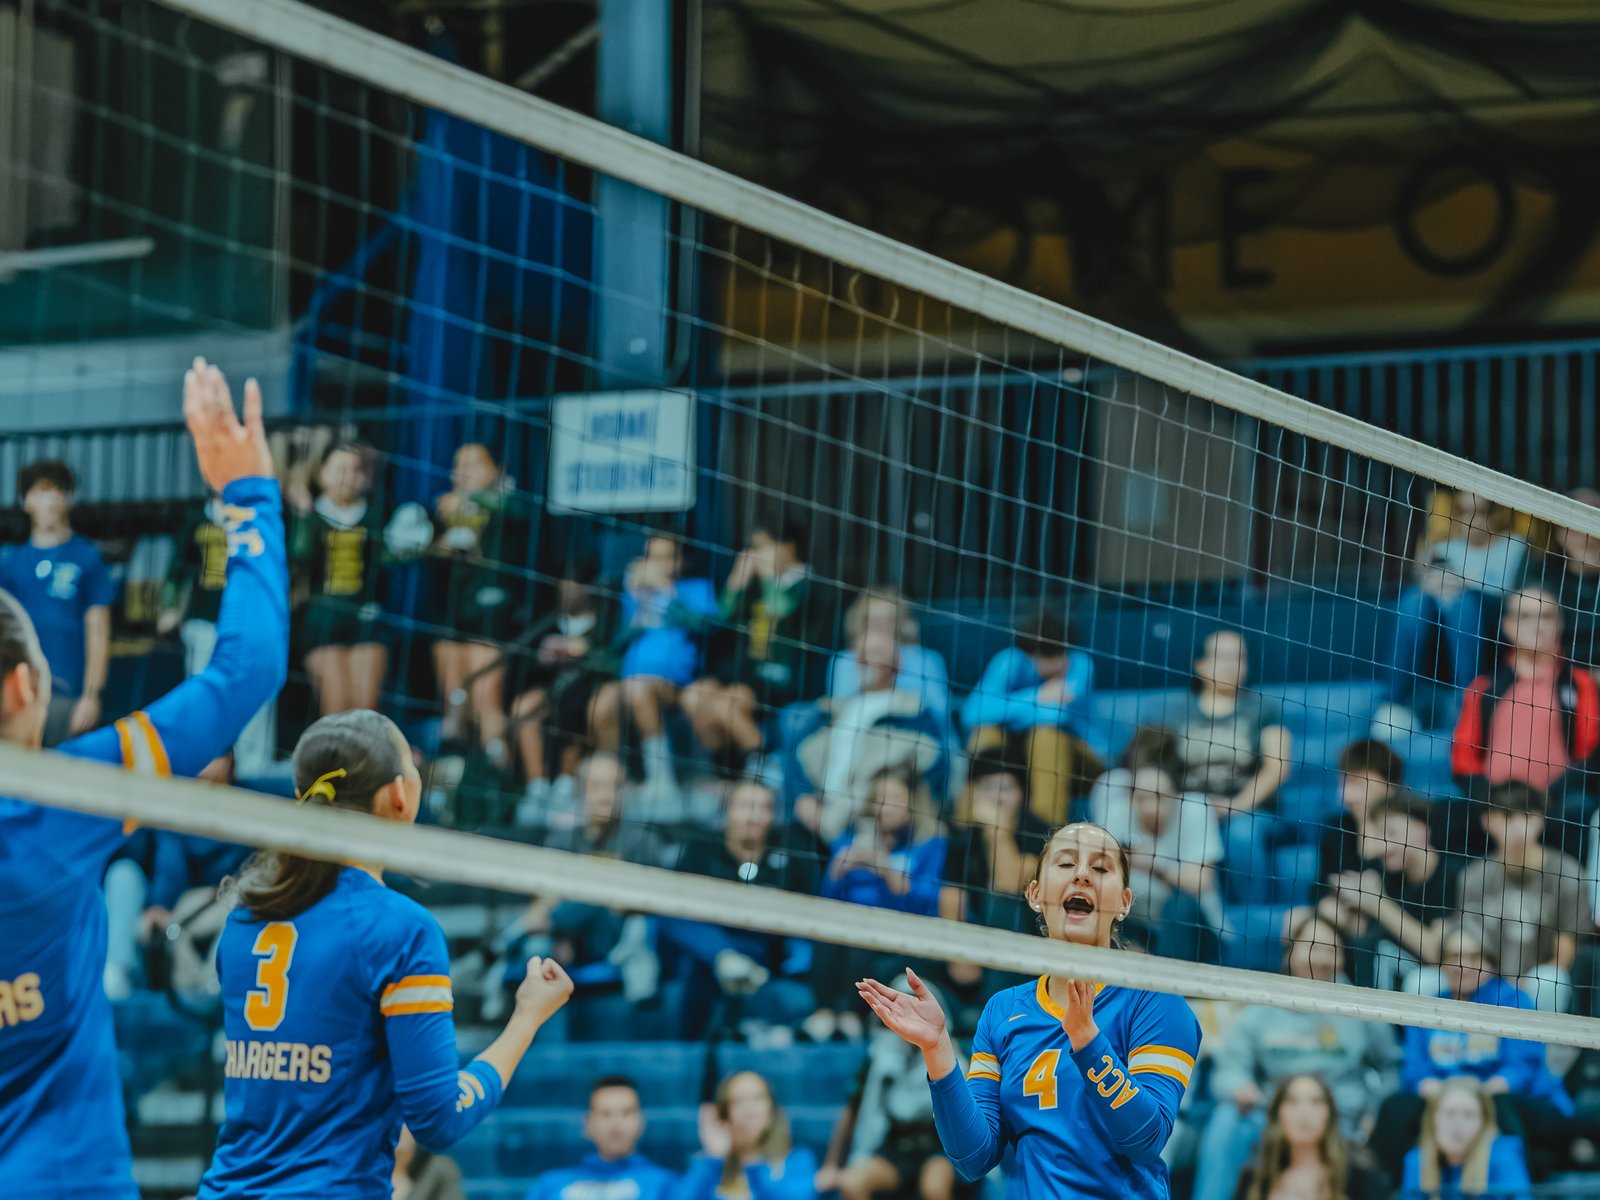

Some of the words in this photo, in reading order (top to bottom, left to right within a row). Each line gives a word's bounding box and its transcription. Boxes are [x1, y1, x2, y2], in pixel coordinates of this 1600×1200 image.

[245, 920, 298, 1031] 3
[225, 1040, 333, 1083] HARGERS
[1023, 1048, 1062, 1110] 4
[1087, 1055, 1140, 1110] ACC
